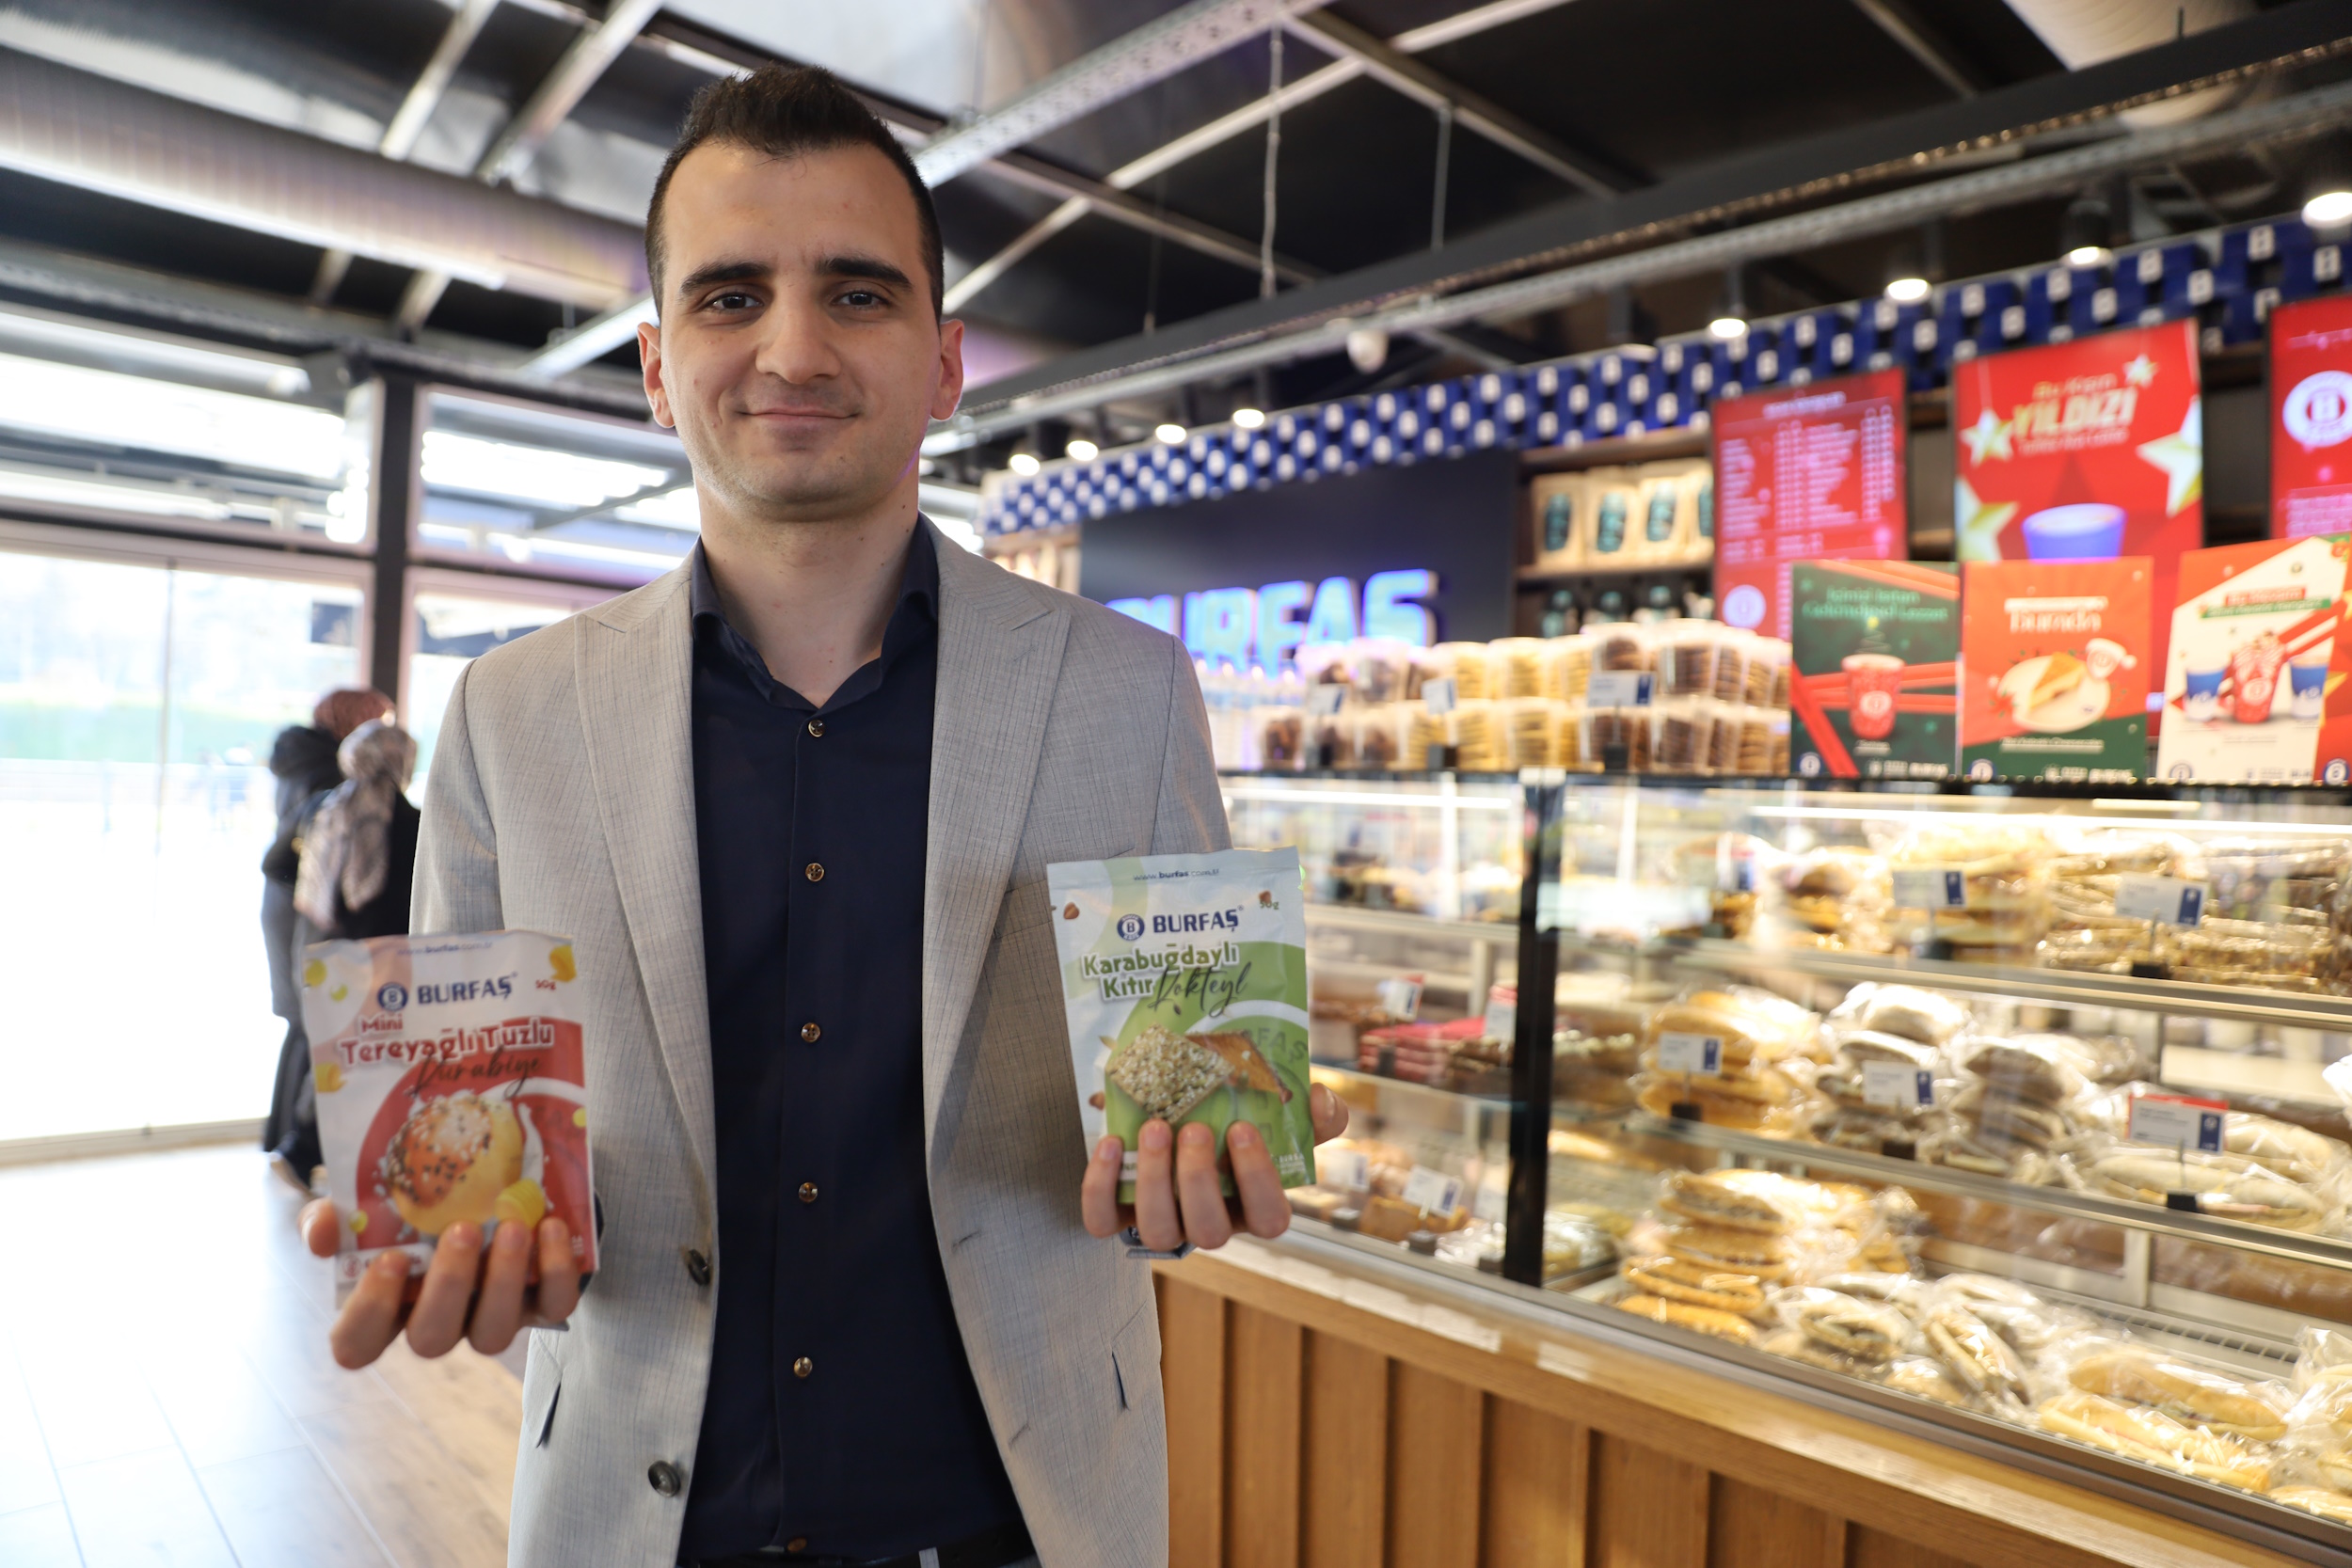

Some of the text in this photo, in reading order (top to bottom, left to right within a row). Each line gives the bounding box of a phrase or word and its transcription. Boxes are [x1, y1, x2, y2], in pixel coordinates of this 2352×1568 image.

[1134, 868, 1219, 881] www.burfas.com.tr
[1152, 908, 1239, 933] BURFAŞ
[1083, 941, 1237, 975] Karabuğdaylı
[417, 975, 513, 1005] BURFAŞ
[1103, 976, 1153, 999] Kıtır
[1147, 960, 1252, 1018] Kokteyl
[361, 1014, 404, 1033] Mini
[340, 1021, 553, 1065] Tereyağlı Tuzlu
[405, 1045, 543, 1101] Kurabiye
